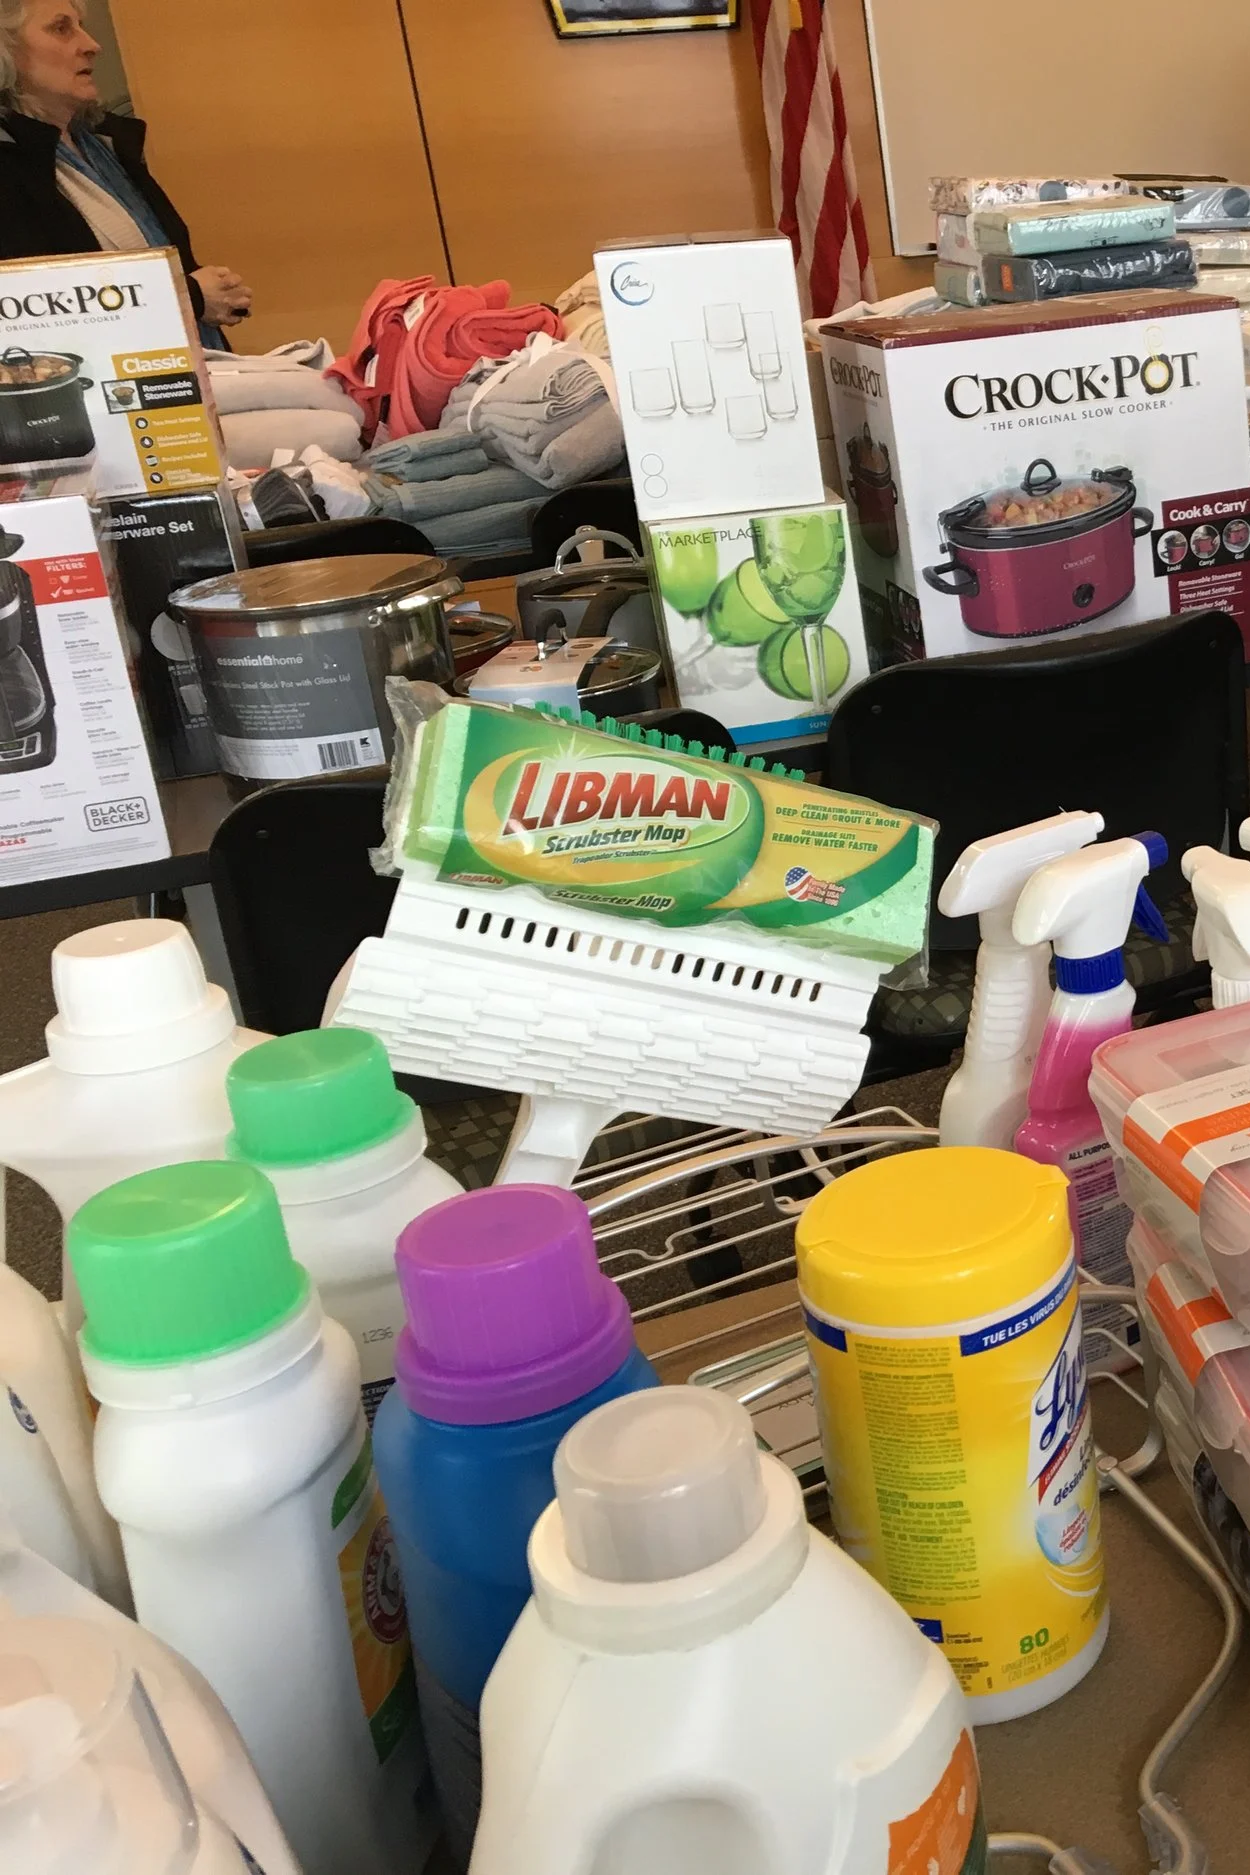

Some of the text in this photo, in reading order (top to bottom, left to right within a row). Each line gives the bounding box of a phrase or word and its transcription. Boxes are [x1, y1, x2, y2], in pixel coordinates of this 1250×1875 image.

[6, 315, 121, 333] ORIGINAL SLOW COOKER
[122, 354, 188, 374] Classic
[142, 380, 193, 393] Removable
[144, 389, 194, 401] Stoneware
[990, 400, 1167, 431] THE ORIGINAL SLOW COOKER
[1169, 499, 1248, 521] Cook & Carry
[105, 512, 147, 528] elain
[104, 520, 195, 541] erware Set
[660, 526, 762, 549] MARKETPLACE
[46, 562, 87, 573] FILTERS:
[1178, 571, 1242, 587] Removable Stoneware
[1179, 593, 1196, 601] Three
[1212, 585, 1235, 595] Settings
[260, 681, 279, 689] Stock
[281, 680, 294, 688] Pot
[296, 678, 312, 688] with
[314, 677, 338, 686] Glass
[339, 674, 351, 682] Lid
[502, 762, 731, 835] LIBMAN
[90, 803, 141, 818] BLACK+
[776, 807, 798, 817] DEEP
[800, 811, 829, 821] CLEAN
[832, 813, 863, 825] GROUT
[874, 819, 901, 828] MORE
[803, 803, 879, 817] PENETRATING BRISTLES
[21, 816, 64, 828] Coffeemaker
[93, 811, 145, 827] DECKER
[1, 828, 52, 840] Programmable
[542, 825, 686, 855] Scrubster Mop
[801, 829, 856, 840] DRAINAGE SLITS
[772, 833, 878, 852] REMOVE WATER FASTER
[572, 849, 651, 864] Trapeador Scrubster
[553, 888, 673, 909] Scrubster Mop
[1230, 1088, 1249, 1098] SET
[1069, 1142, 1111, 1160] ALL PURPOS
[981, 1329, 1005, 1347] TUE
[1007, 1320, 1029, 1337] LES
[1029, 1299, 1055, 1326] VIRUS
[1020, 1627, 1050, 1655] 80
